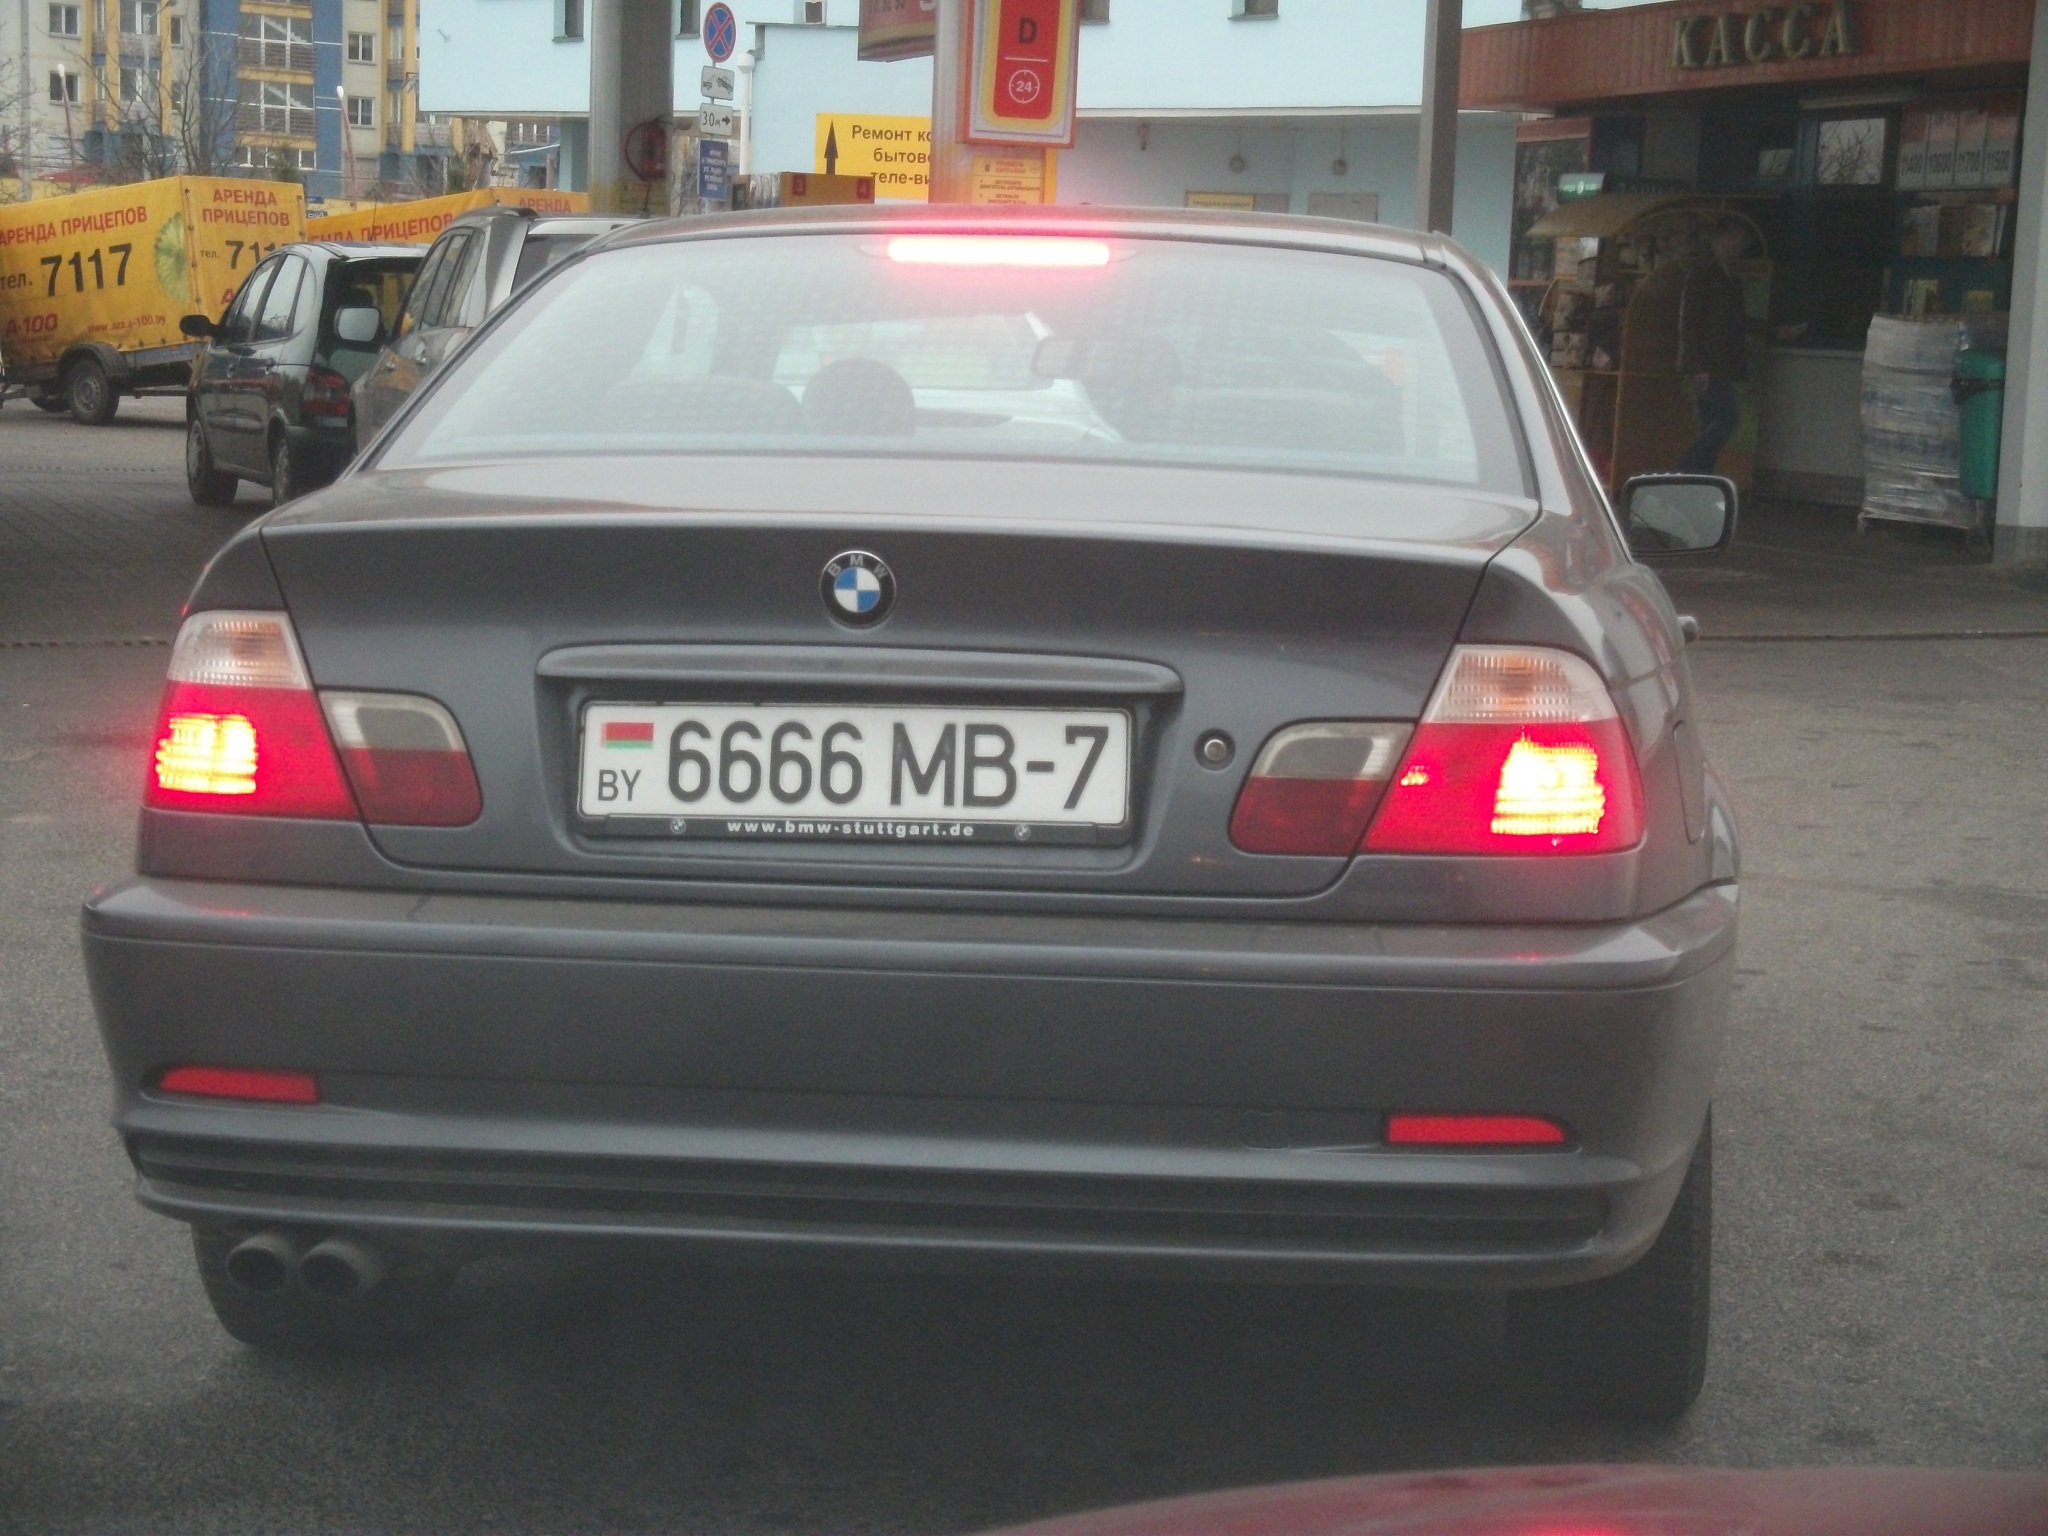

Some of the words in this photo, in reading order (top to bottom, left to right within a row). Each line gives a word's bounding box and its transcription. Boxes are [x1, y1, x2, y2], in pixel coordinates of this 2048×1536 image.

[1018, 17, 1038, 45] D
[1670, 3, 1852, 68] КАССА
[1015, 80, 1033, 93] 24
[851, 124, 912, 141] Ремонт
[873, 147, 931, 163] бытов
[213, 188, 278, 207] АРЕНДА
[0, 222, 57, 246] АРЕНДА
[61, 205, 148, 237] ПРИЦЕПОВ
[202, 208, 290, 227] ПРИЦЕПОВ
[201, 249, 220, 259] тел.
[225, 240, 290, 269] 71
[41, 243, 132, 297] 7117
[827, 554, 888, 578] BMW
[667, 719, 864, 805] 6666
[890, 722, 1109, 810] MB-7
[599, 769, 641, 802] BY
[727, 820, 974, 838] www.bmw-stuttgart.de
